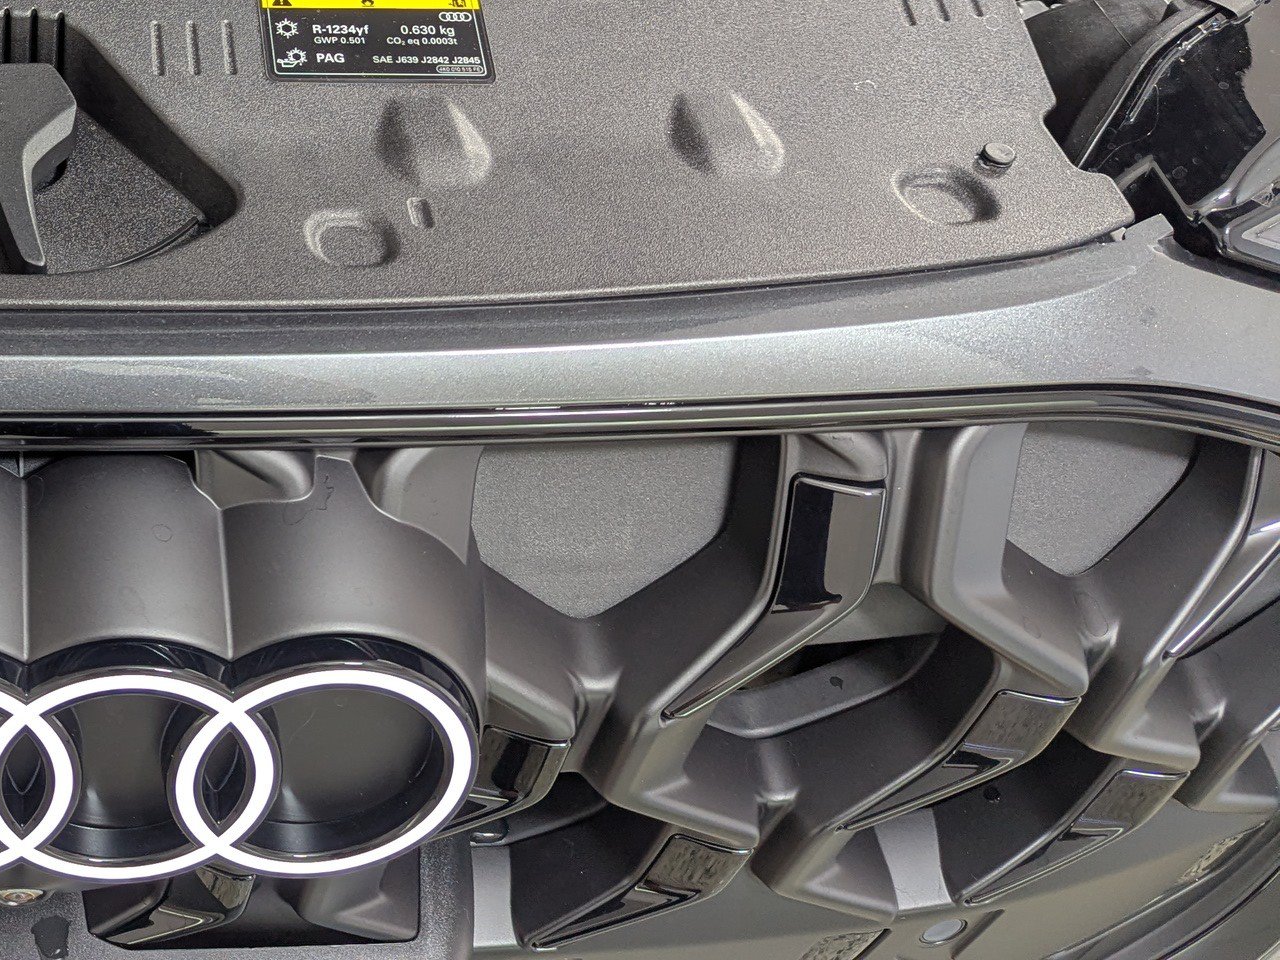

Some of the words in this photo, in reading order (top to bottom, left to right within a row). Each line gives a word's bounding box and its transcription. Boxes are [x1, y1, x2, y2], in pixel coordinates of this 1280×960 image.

[312, 24, 369, 36] R-1234yf
[400, 25, 436, 34] 0.630
[440, 25, 455, 36] kg
[316, 52, 345, 63] PAG
[372, 55, 393, 64] SAE
[396, 56, 419, 64] J639
[420, 56, 450, 64] J2842
